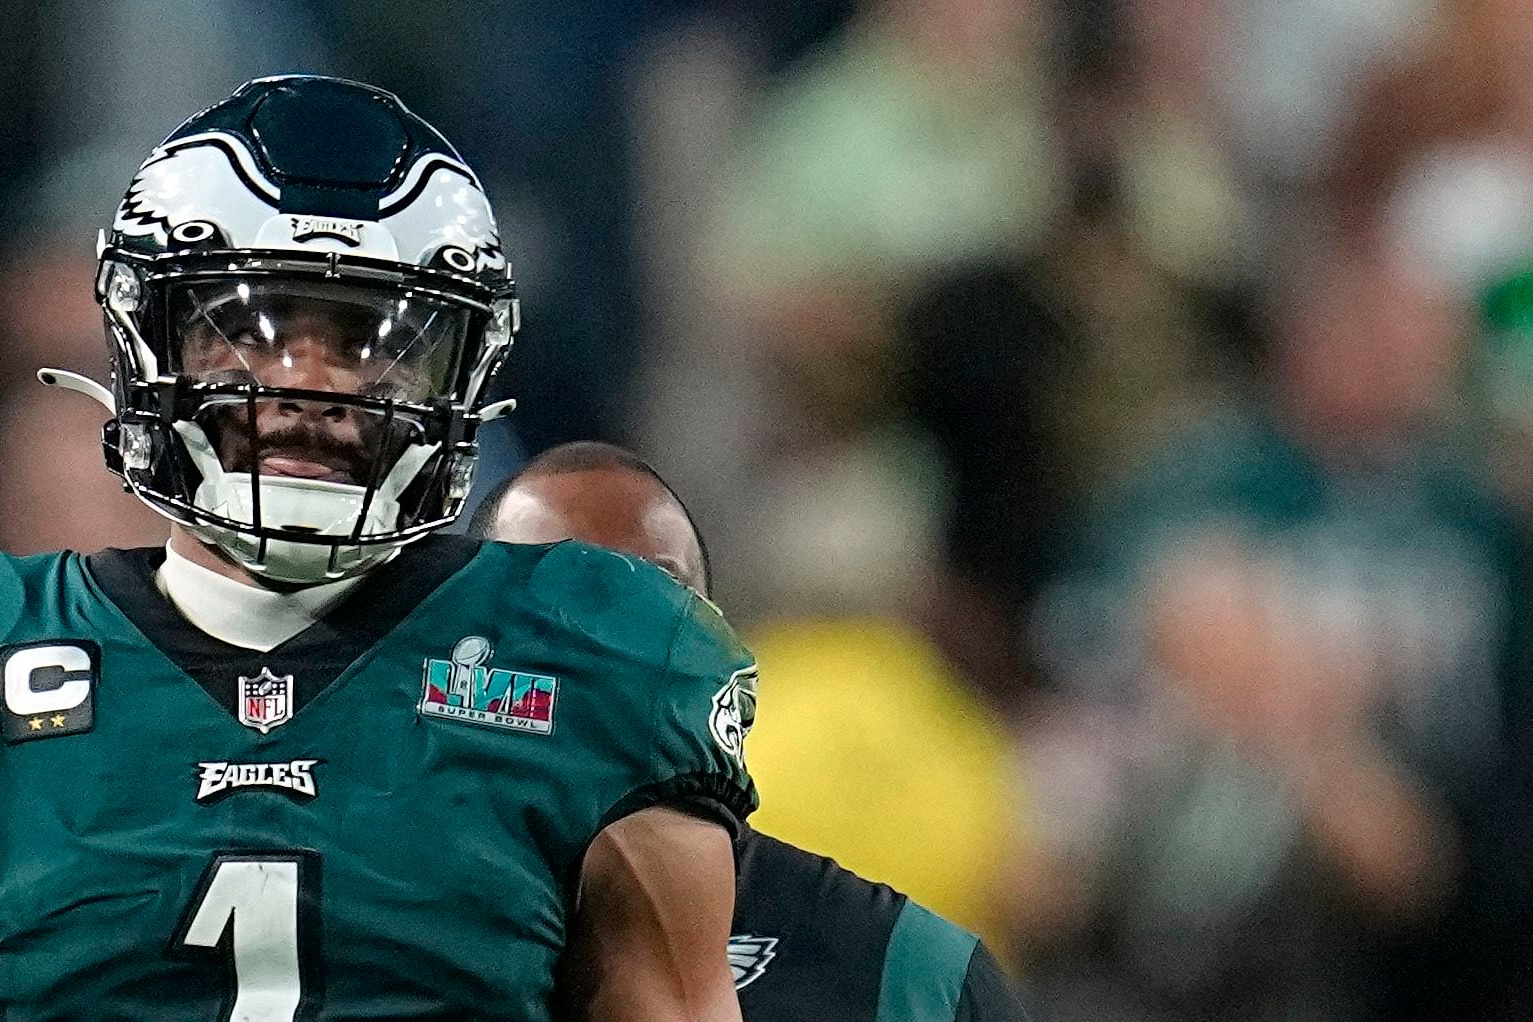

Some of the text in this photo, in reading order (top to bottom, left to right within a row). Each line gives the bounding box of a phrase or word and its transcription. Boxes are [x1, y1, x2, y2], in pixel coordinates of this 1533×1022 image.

[5, 646, 92, 715] C
[248, 697, 284, 720] NFL
[437, 705, 539, 730] SUPER BOWL
[196, 759, 319, 800] EAGLES
